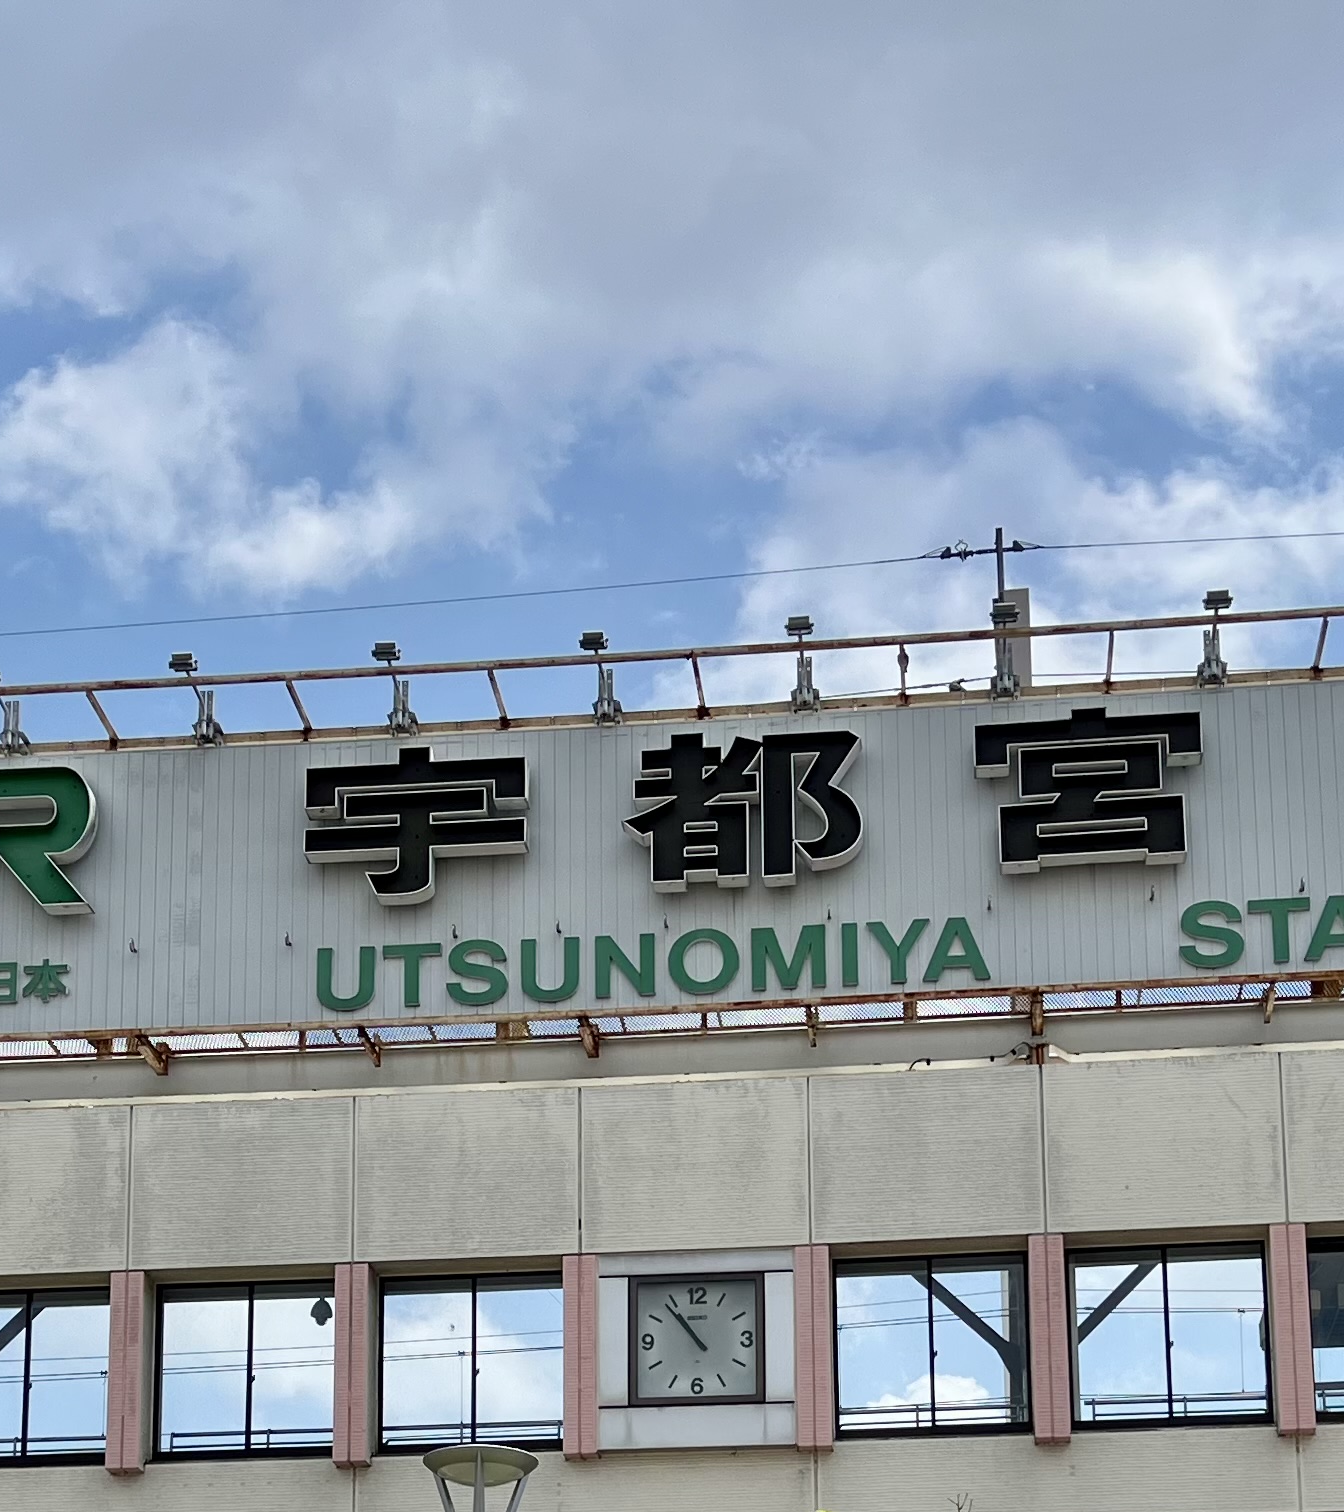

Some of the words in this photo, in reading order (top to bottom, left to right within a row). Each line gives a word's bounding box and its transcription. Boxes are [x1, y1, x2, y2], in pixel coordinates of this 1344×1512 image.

[316, 916, 991, 1012] UTSUNOMIYA
[687, 1287, 708, 1305] 12
[641, 1333, 655, 1351] 9
[740, 1330, 754, 1348] 3
[690, 1377, 704, 1395] 6
